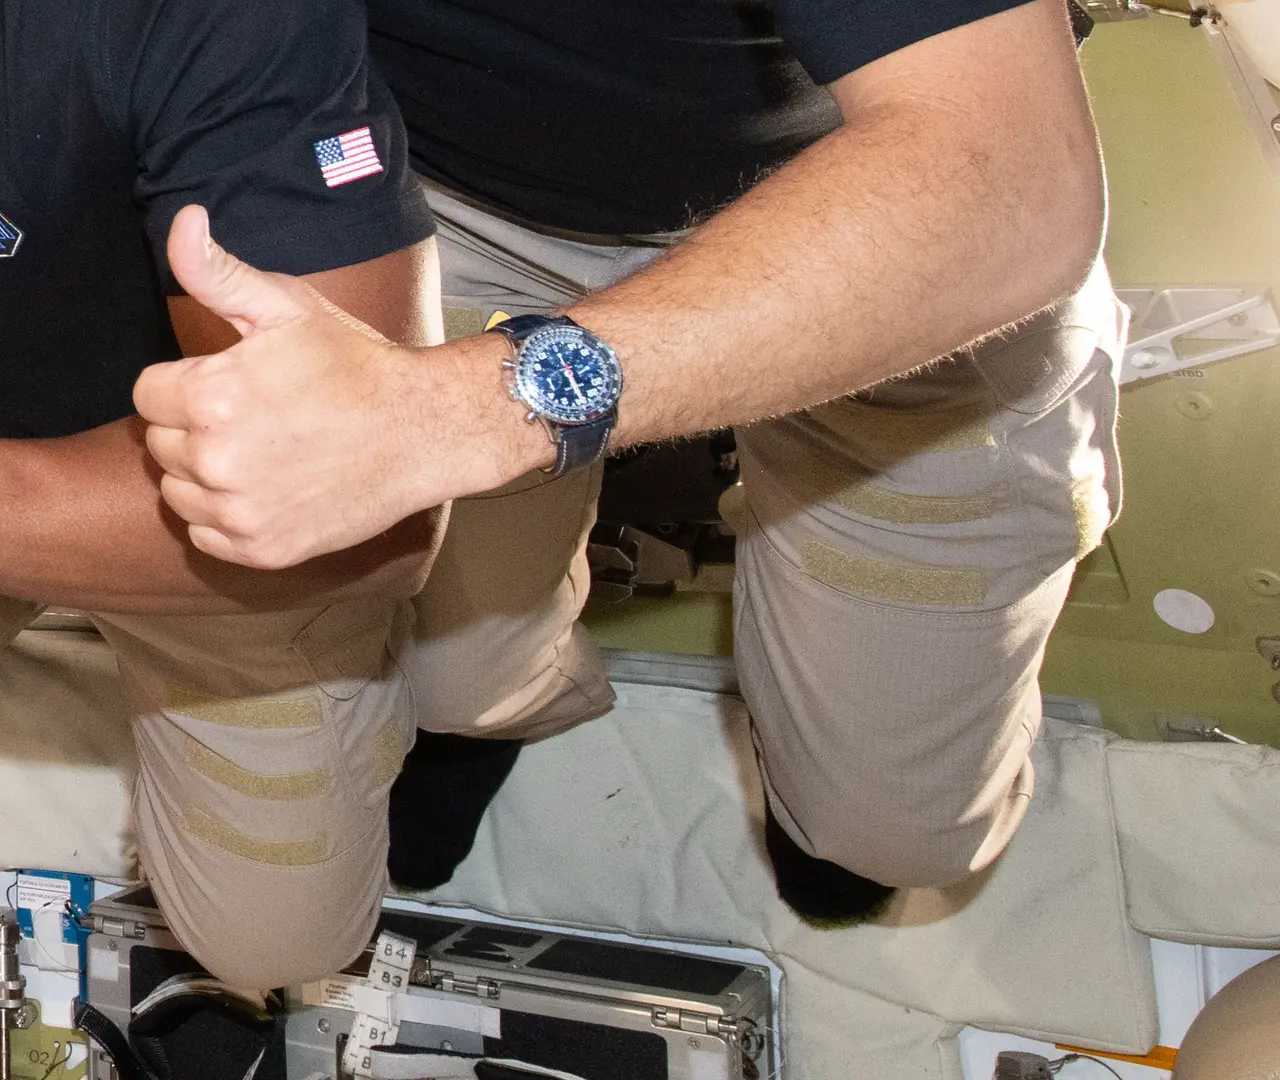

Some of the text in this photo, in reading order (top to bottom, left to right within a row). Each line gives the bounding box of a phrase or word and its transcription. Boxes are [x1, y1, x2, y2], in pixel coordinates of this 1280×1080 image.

[1173, 369, 1204, 378] STBD
[384, 943, 408, 960] 84
[381, 971, 404, 988] 83
[369, 1027, 387, 1044] 81
[361, 1056, 372, 1070] 8
